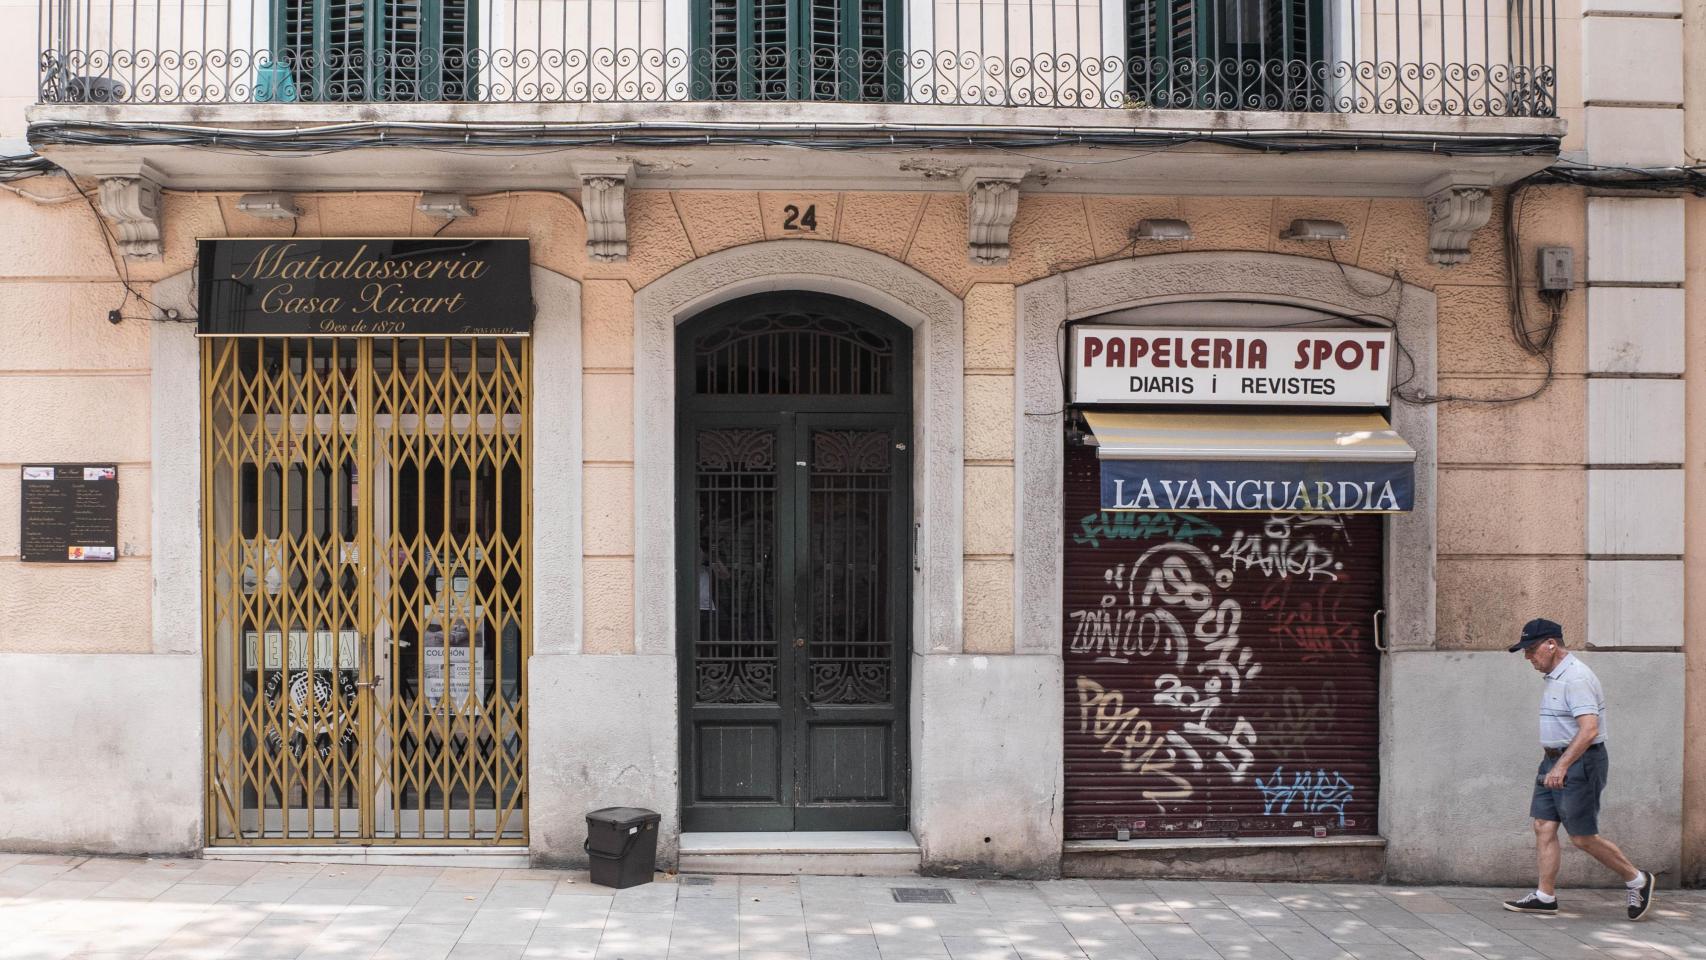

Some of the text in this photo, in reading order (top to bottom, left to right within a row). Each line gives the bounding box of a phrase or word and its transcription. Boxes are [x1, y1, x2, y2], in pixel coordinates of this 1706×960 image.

[783, 203, 818, 231] 24
[231, 243, 491, 280] Matalasseria
[260, 282, 466, 314] Casa Xicart
[319, 319, 406, 334] Des de 1870
[1083, 336, 1386, 371] PAPELERIA SPOT
[1130, 375, 1195, 394] DIARIS
[1241, 377, 1336, 395] REVISTES
[1113, 478, 1400, 511] LA VANGUARDIA
[247, 632, 354, 668] REBAJA
